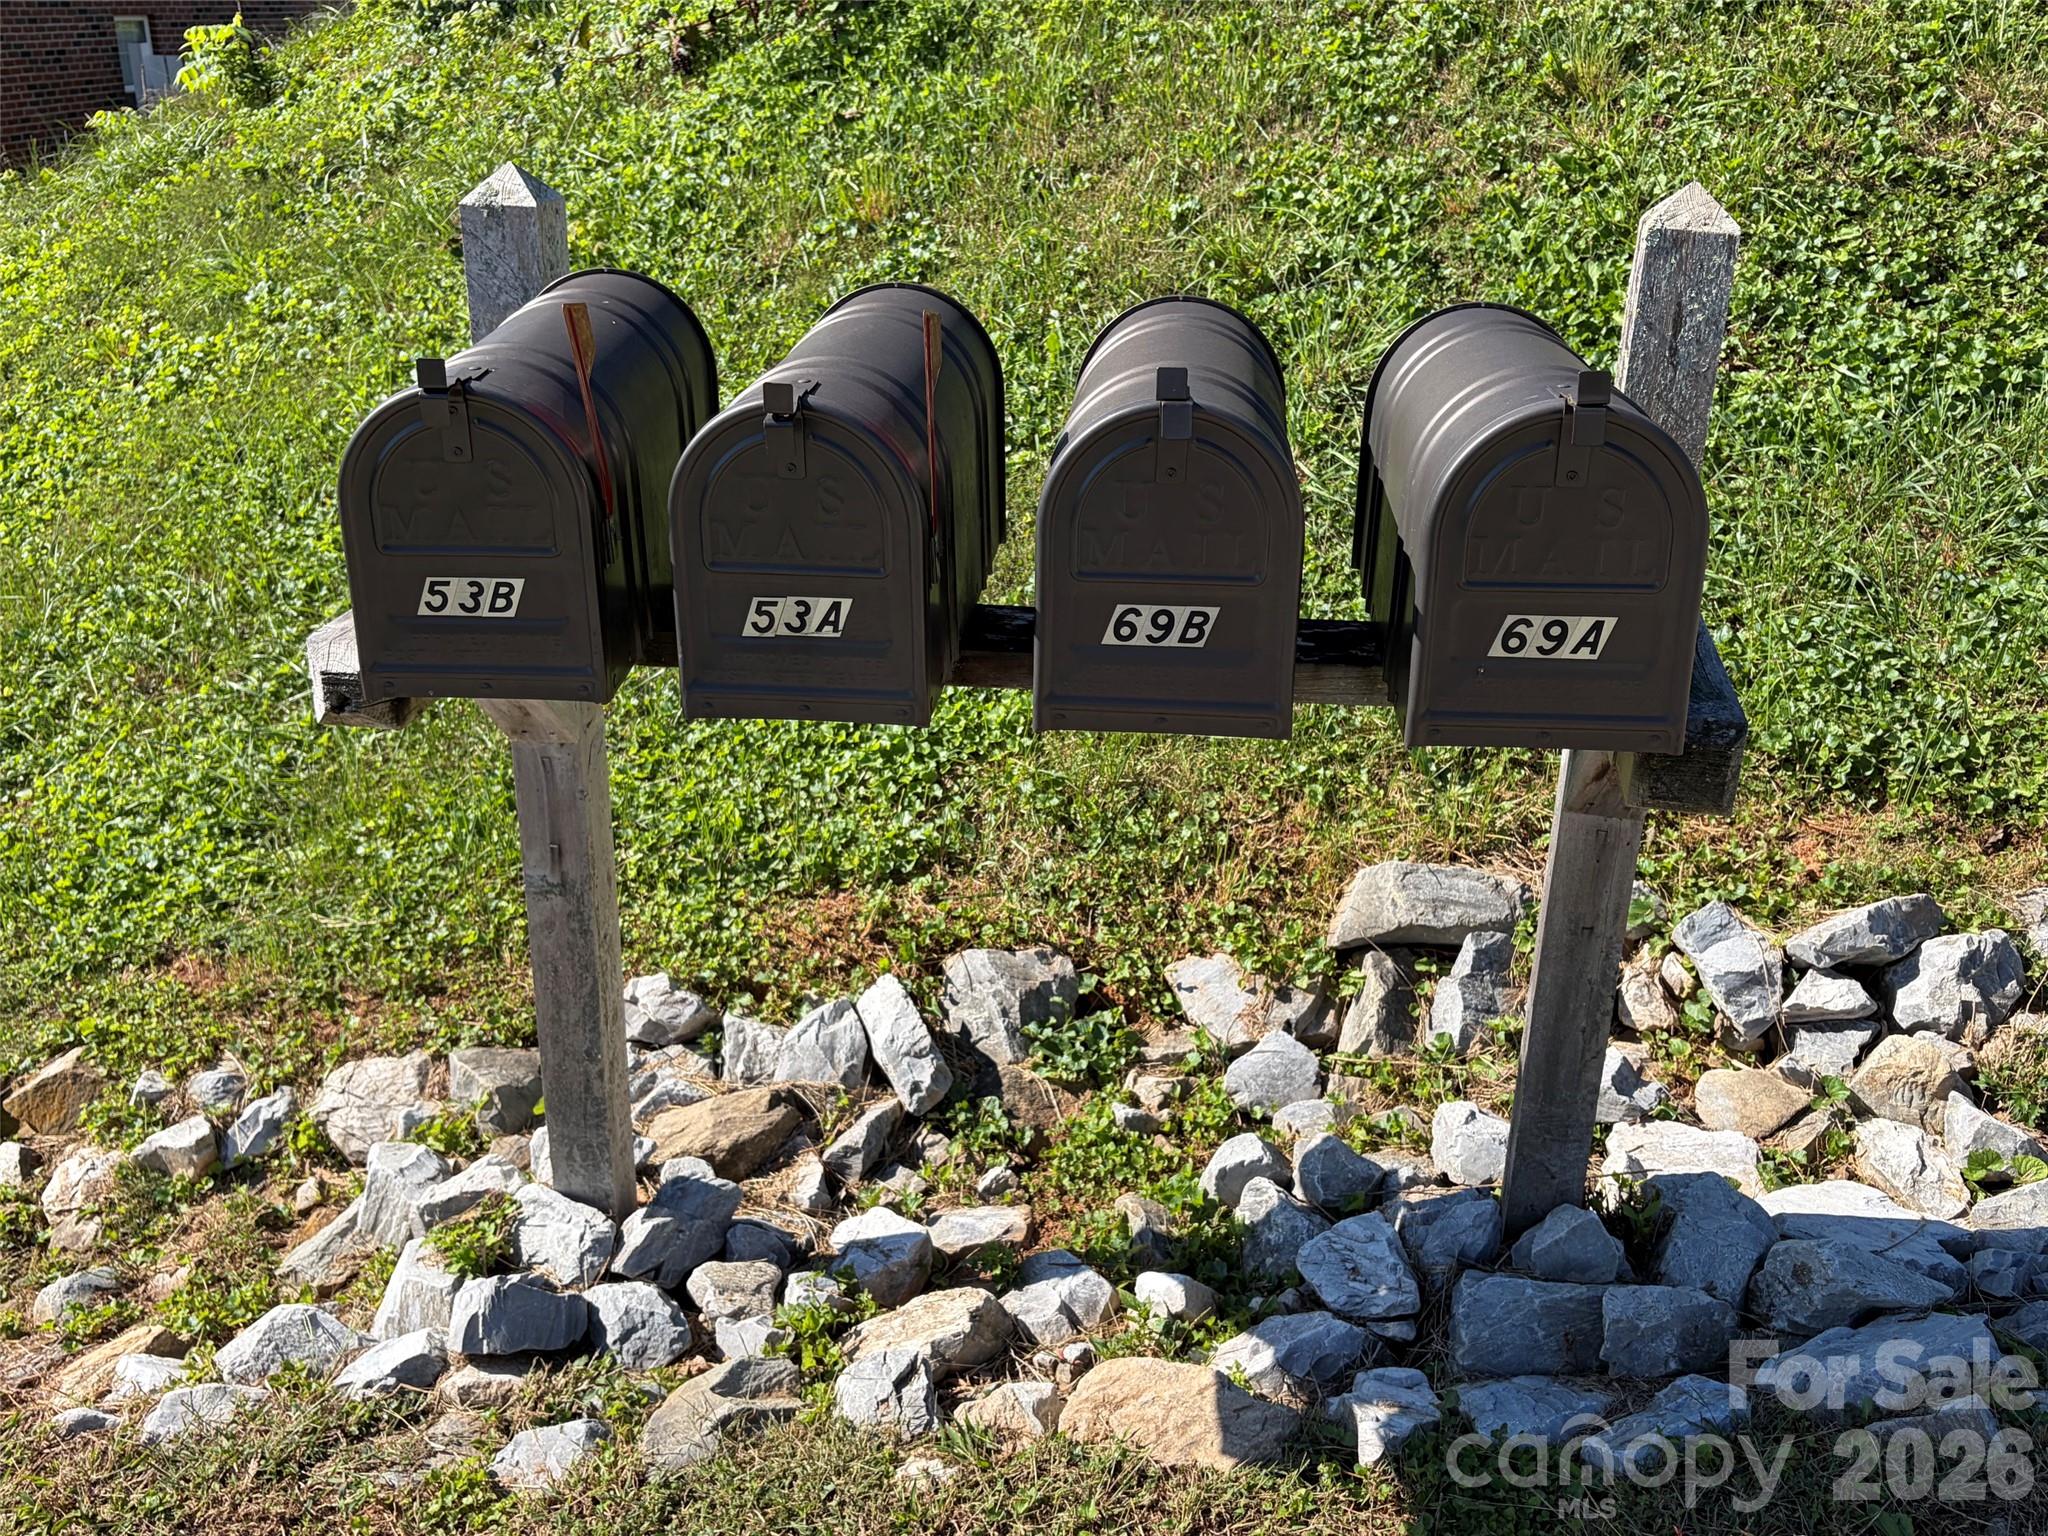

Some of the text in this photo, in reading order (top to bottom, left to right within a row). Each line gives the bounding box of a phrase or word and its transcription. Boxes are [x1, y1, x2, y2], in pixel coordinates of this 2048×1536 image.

[818, 475, 844, 518] S
[1114, 480, 1225, 524] U S
[1507, 484, 1627, 530] U S
[1081, 529, 1255, 573] MAIL
[1470, 535, 1656, 579] MAIL
[424, 581, 515, 613] 53B
[751, 601, 842, 632] 53A
[1114, 608, 1210, 644] 69B
[1502, 619, 1606, 655] 69A
